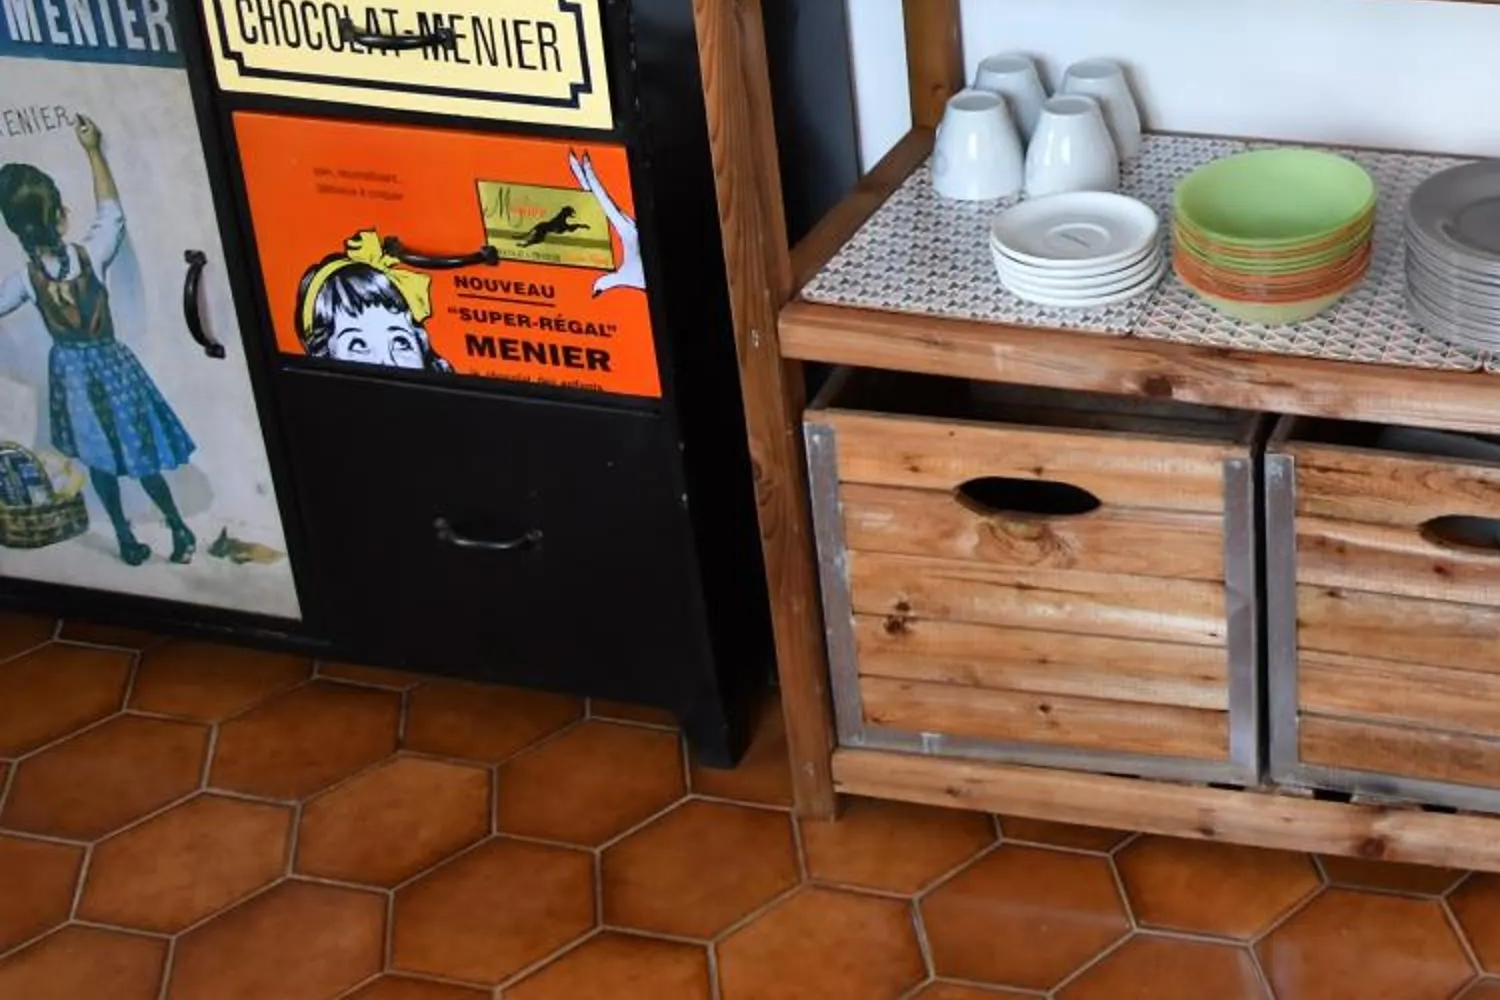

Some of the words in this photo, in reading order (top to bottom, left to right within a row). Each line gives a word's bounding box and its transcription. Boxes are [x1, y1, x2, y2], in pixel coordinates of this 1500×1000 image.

[0, 105, 72, 136] ENIER
[454, 275, 555, 299] NOUVEAU
[465, 333, 612, 373] MENIER
